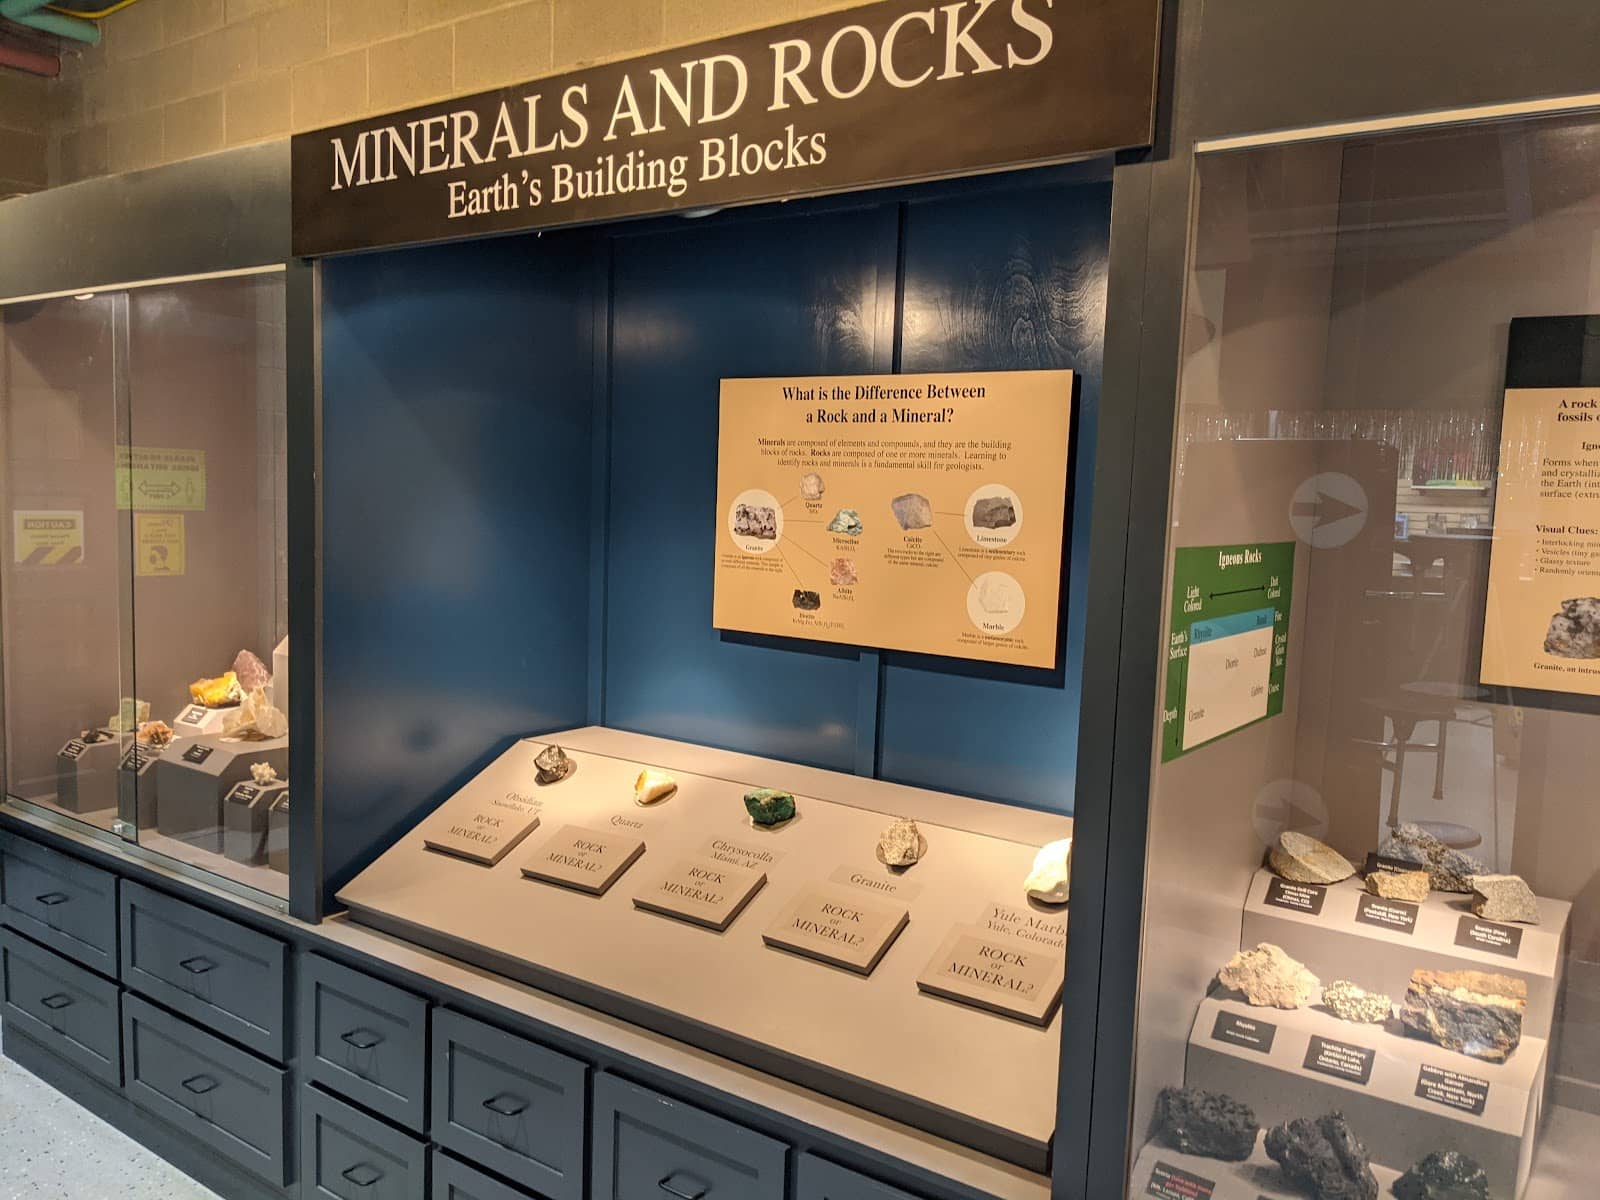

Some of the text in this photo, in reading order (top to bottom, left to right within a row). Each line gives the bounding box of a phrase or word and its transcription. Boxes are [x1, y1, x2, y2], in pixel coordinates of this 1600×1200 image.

[330, 0, 1054, 191] MINERALS AND ROCKS
[448, 125, 827, 220] Earth's Building Blocks
[782, 384, 986, 400] What is the Difference Between
[1559, 399, 1598, 409] A rock
[806, 408, 954, 424] a Rock and a Mineral?
[1557, 412, 1593, 422] fossils
[758, 438, 785, 447] Minerals
[798, 440, 828, 449] composed
[838, 440, 866, 448] elements
[868, 440, 880, 448] and
[881, 440, 922, 450] compounds,
[924, 440, 936, 449] and
[938, 440, 952, 450] they
[968, 440, 980, 449] the
[981, 440, 1012, 451] building
[761, 448, 780, 457] blocks
[781, 448, 788, 457] of
[811, 449, 831, 457] Rocks
[843, 450, 876, 459] composed
[877, 450, 884, 458] of
[928, 451, 960, 459] minerals.
[965, 451, 997, 461] Learning
[999, 452, 1007, 460] to
[802, 459, 819, 467] rocks
[820, 459, 831, 467] and
[832, 460, 859, 468] minerals
[874, 460, 915, 469] fundamental
[917, 461, 932, 470] skill
[934, 462, 943, 470] for
[946, 462, 984, 472] geologists.
[1543, 458, 1599, 467] Forms when
[1542, 469, 1558, 477] and
[1558, 480, 1582, 488] Earth
[1540, 490, 1572, 498] surface
[1536, 525, 1599, 535] Visual Clues:
[1218, 548, 1262, 570] Igneous Rocks
[1540, 567, 1576, 576] Randomly
[983, 622, 1005, 630] Marble
[474, 814, 504, 828] ROCK
[610, 815, 644, 829] Quartz
[448, 826, 499, 844] MINERAL?
[573, 840, 607, 854] ROCK
[712, 840, 774, 864] Chrysocolla
[546, 852, 603, 872] MINERAL?
[688, 867, 726, 884] ROCK
[850, 874, 897, 894] Granite
[660, 881, 724, 905] MINERAL?
[821, 904, 864, 923] ROCK
[993, 908, 1021, 924] Yule
[792, 918, 865, 947] MINERAL?
[987, 920, 1011, 935] Yule,
[979, 945, 1028, 967] ROCK
[948, 962, 1034, 994] MINERAL?
